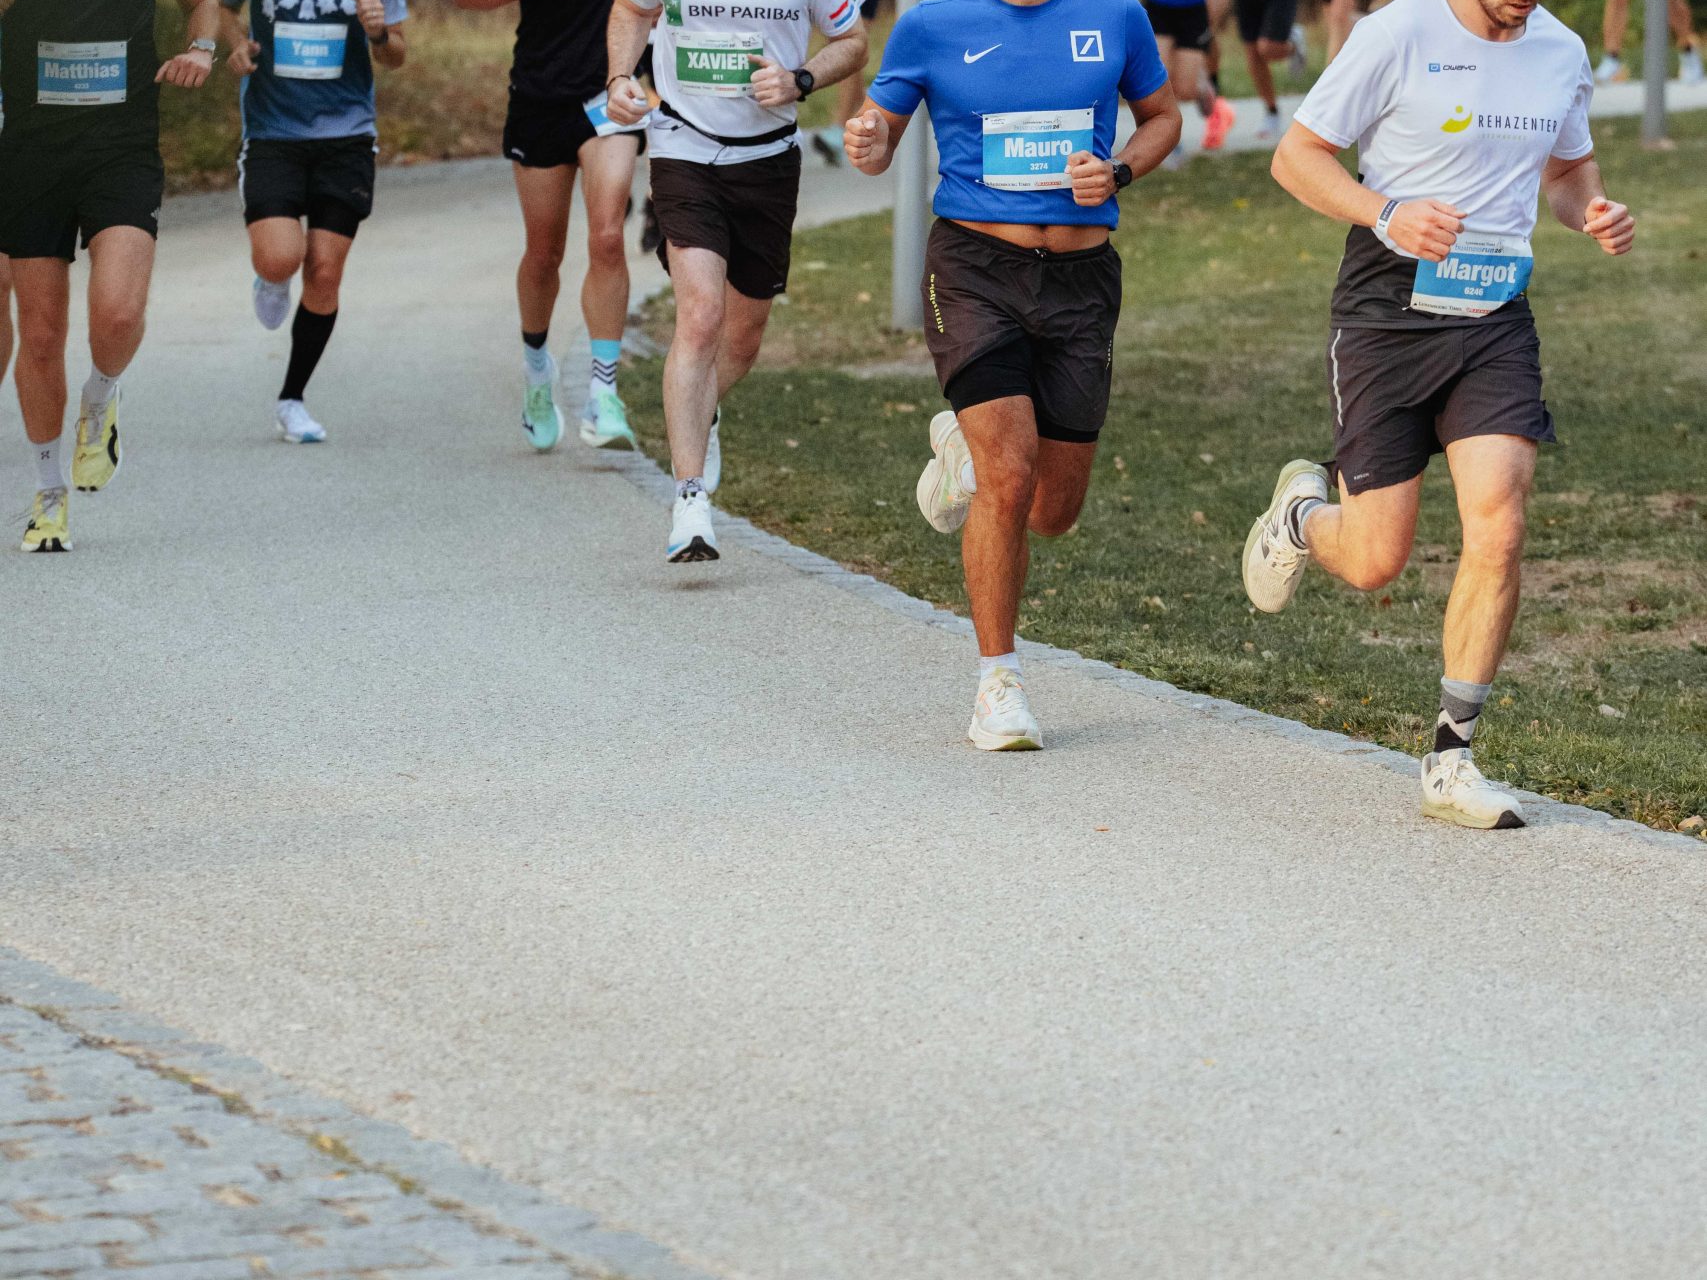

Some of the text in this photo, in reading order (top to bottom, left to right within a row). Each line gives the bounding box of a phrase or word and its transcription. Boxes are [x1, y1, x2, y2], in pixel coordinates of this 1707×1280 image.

[688, 5, 800, 21] BNP PARIBAS
[292, 40, 329, 57] Yann
[687, 52, 750, 70] XAVIER
[44, 62, 120, 79] Matthias
[1478, 114, 1558, 133] REHAZENTER
[1004, 137, 1073, 158] Mauro
[1030, 162, 1049, 171] 3274
[1435, 257, 1517, 287] Margot
[1464, 286, 1484, 296] 6246
